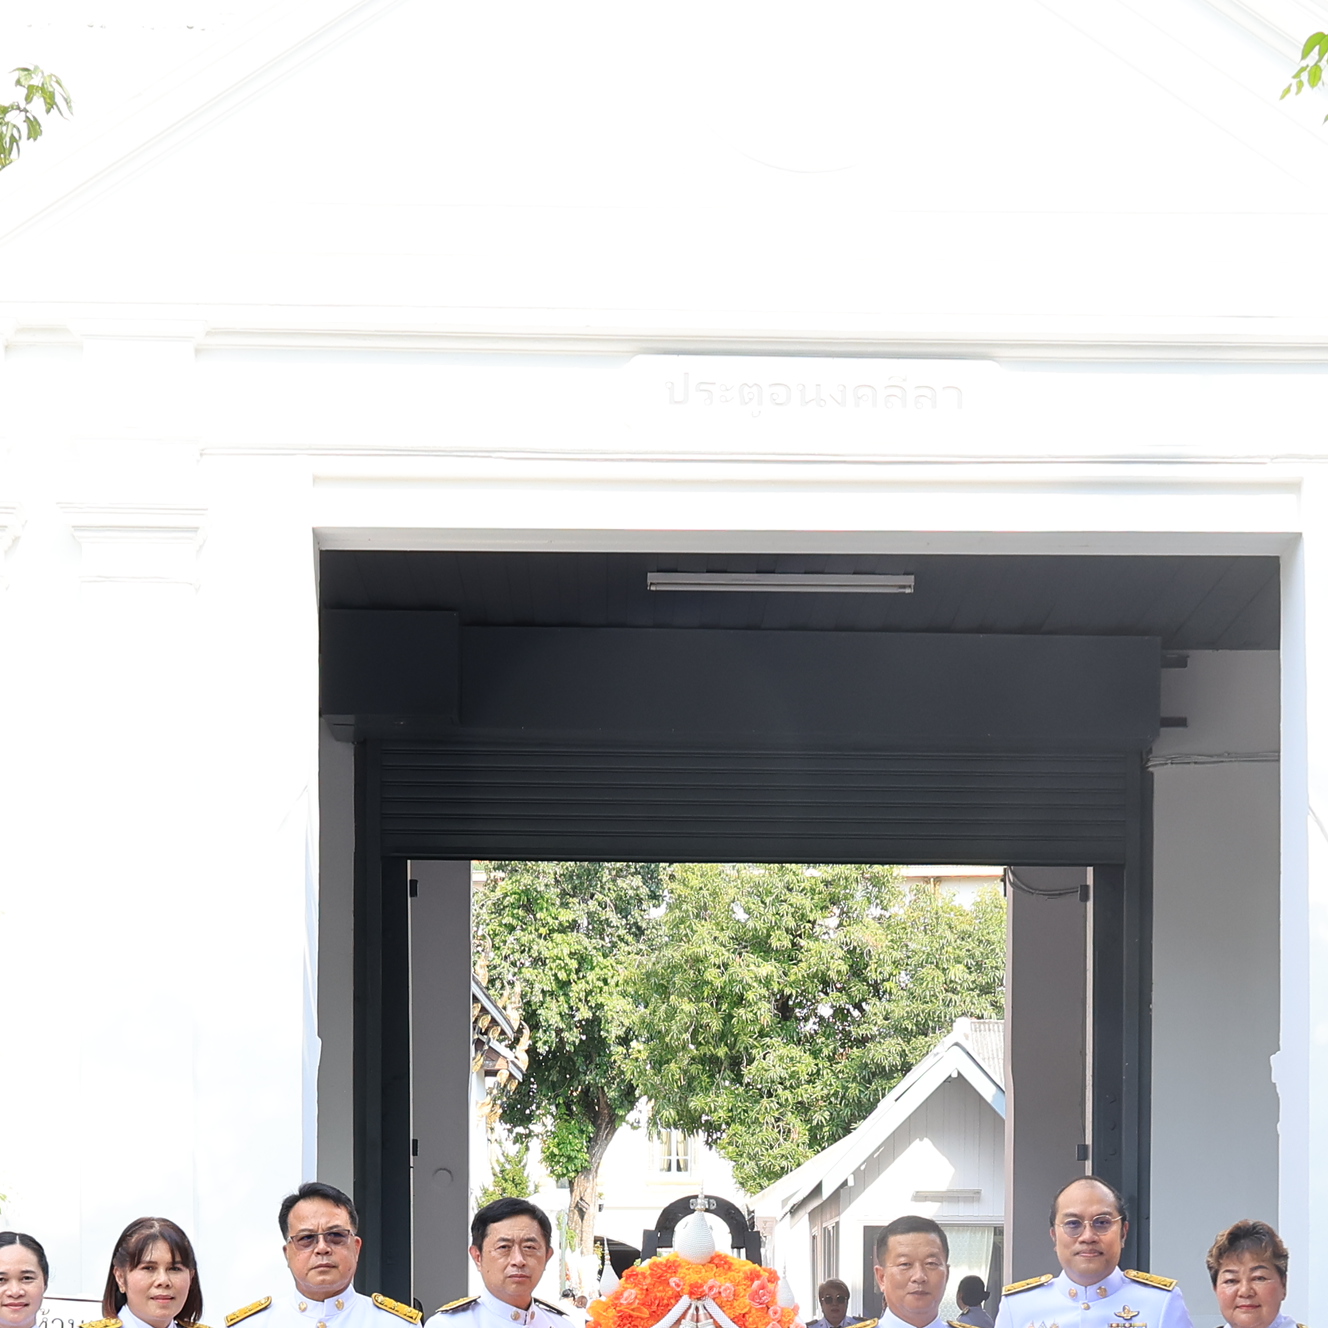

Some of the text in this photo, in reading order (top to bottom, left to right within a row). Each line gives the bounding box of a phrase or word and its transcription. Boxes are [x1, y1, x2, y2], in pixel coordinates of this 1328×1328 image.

[664, 371, 964, 418] ประตูอนงคลีลา
